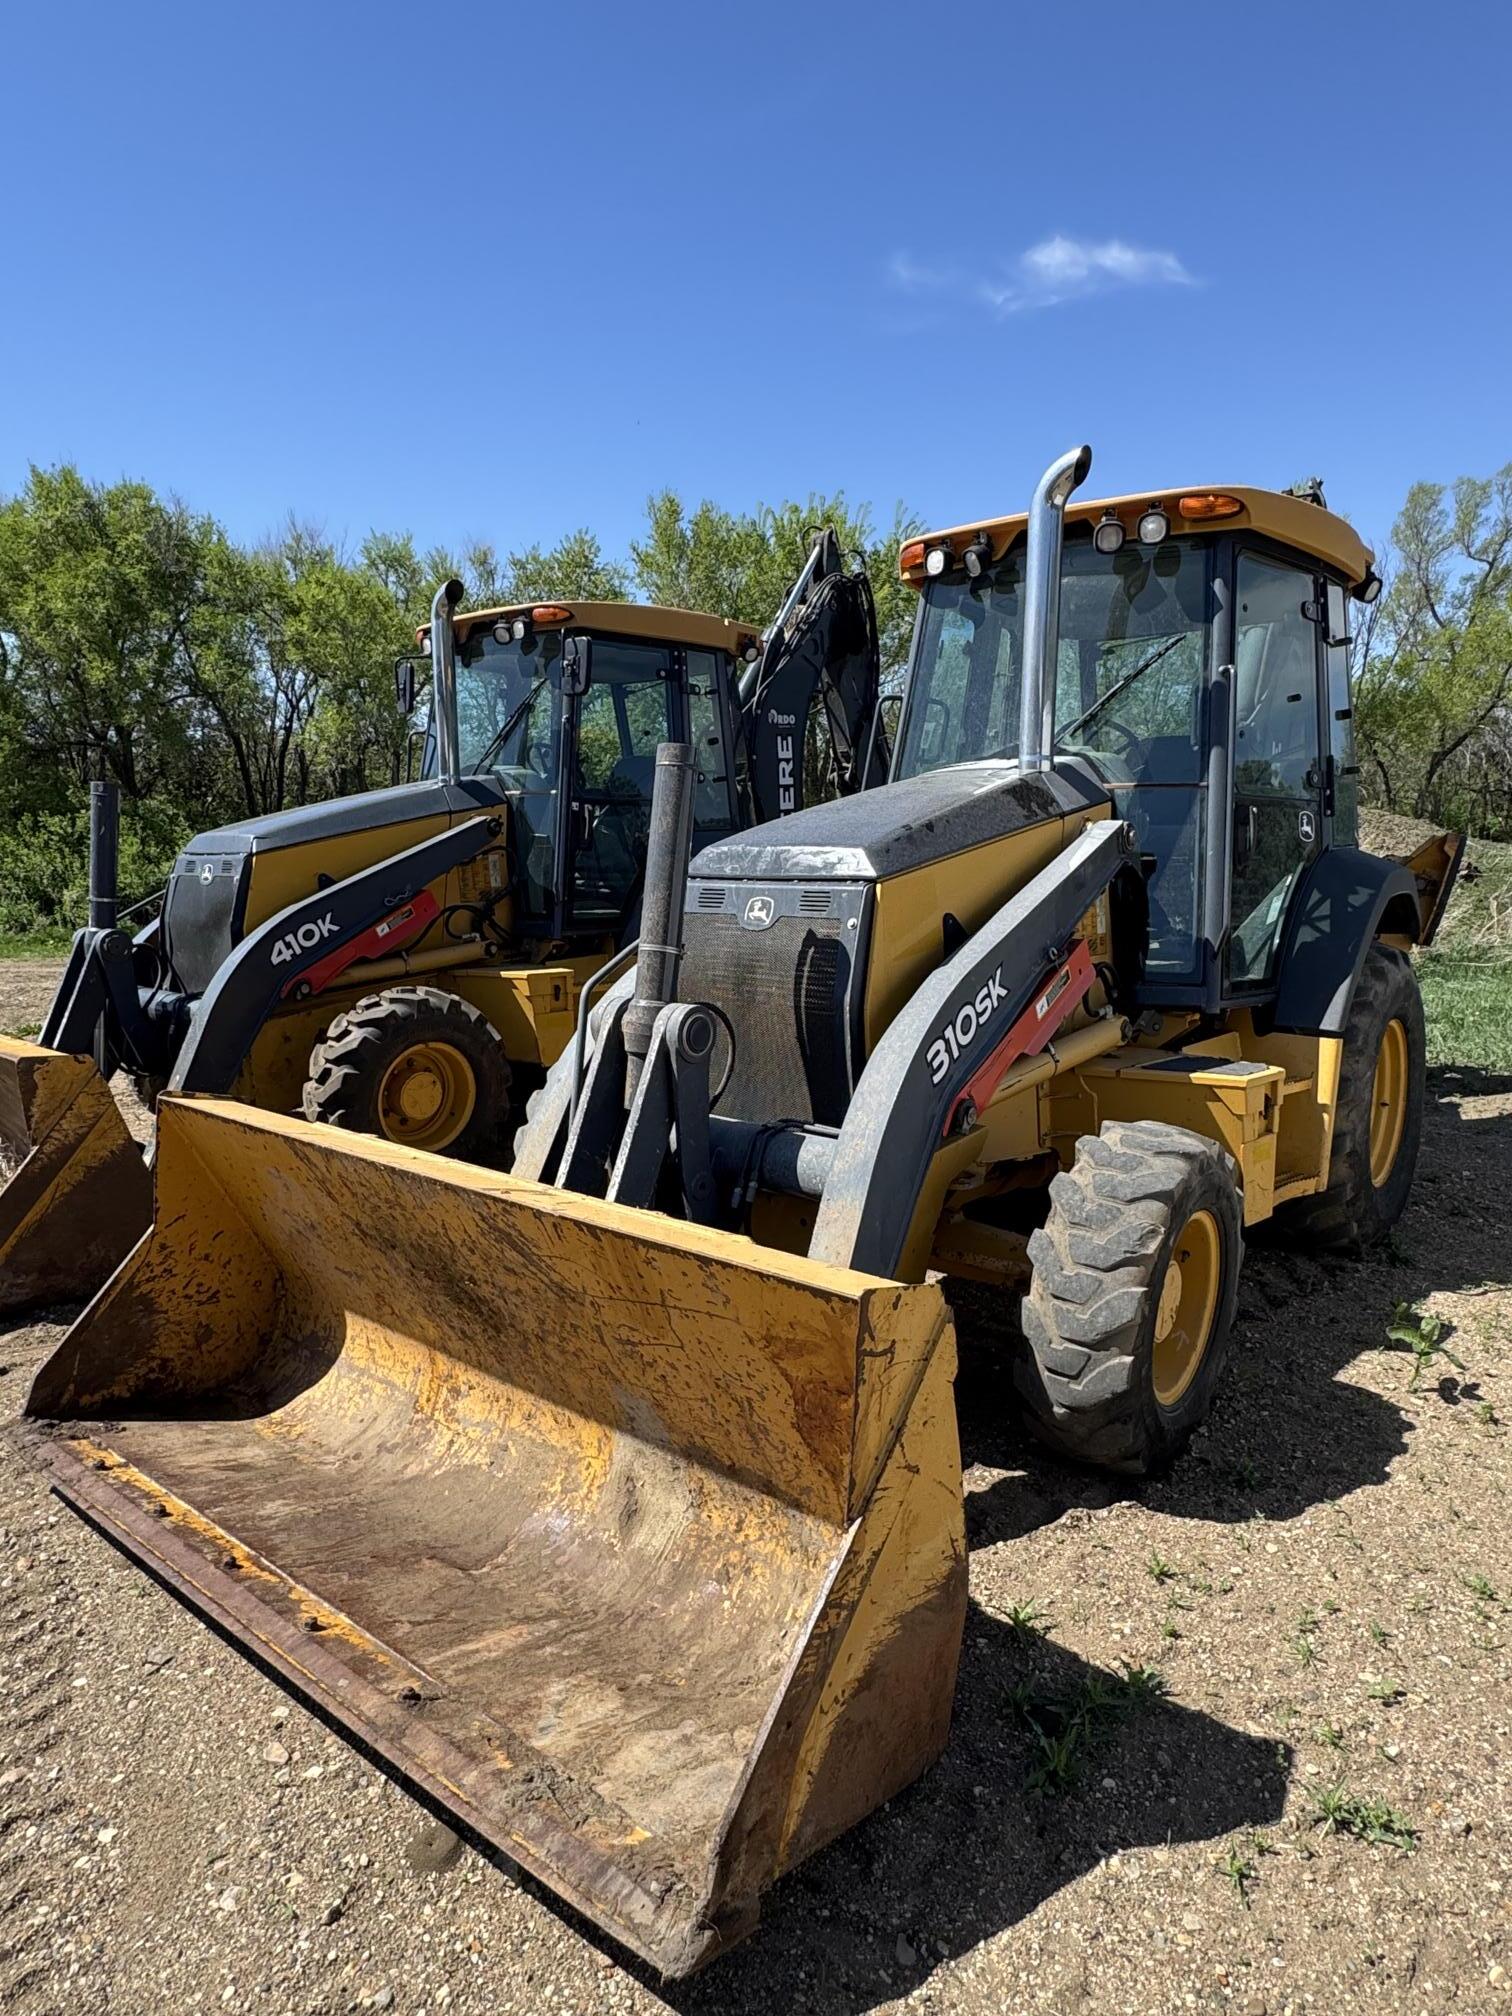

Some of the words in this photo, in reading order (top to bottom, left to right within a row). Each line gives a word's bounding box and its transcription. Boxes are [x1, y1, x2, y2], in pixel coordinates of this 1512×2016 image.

[777, 735, 795, 818] ERE
[270, 912, 341, 966] 410K
[926, 963, 1009, 1086] 310SK
